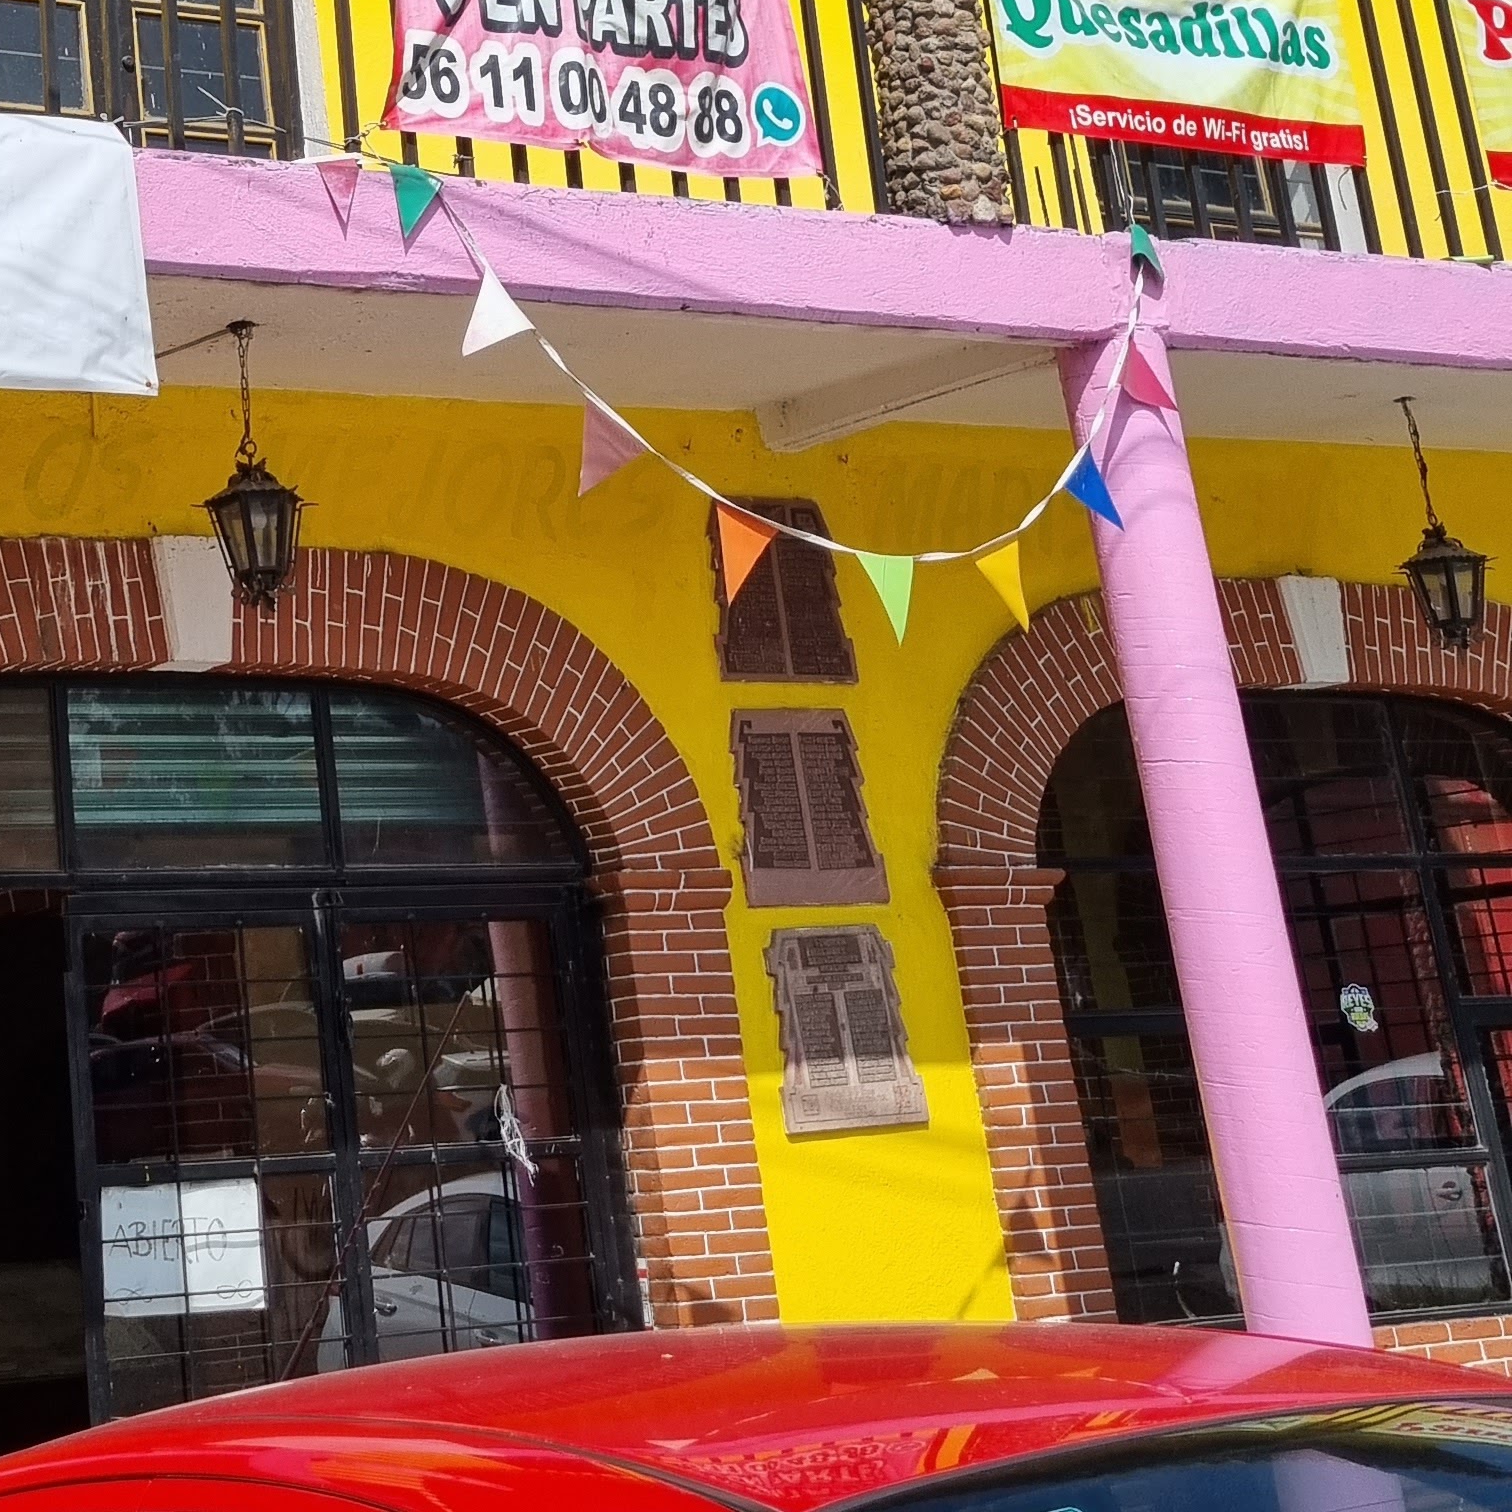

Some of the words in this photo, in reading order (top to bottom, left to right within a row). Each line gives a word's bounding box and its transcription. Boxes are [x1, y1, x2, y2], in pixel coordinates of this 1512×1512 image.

[401, 42, 462, 105] 56
[478, 53, 537, 113] 11
[557, 62, 608, 126] 00
[617, 79, 679, 138] 48
[692, 85, 744, 146] 88
[1068, 103, 1167, 135] ¡Servicio
[1172, 114, 1198, 137] de
[1203, 116, 1247, 145] Wi-Fi
[1250, 129, 1310, 152] gratis!
[108, 1216, 228, 1265] ABIERTO
